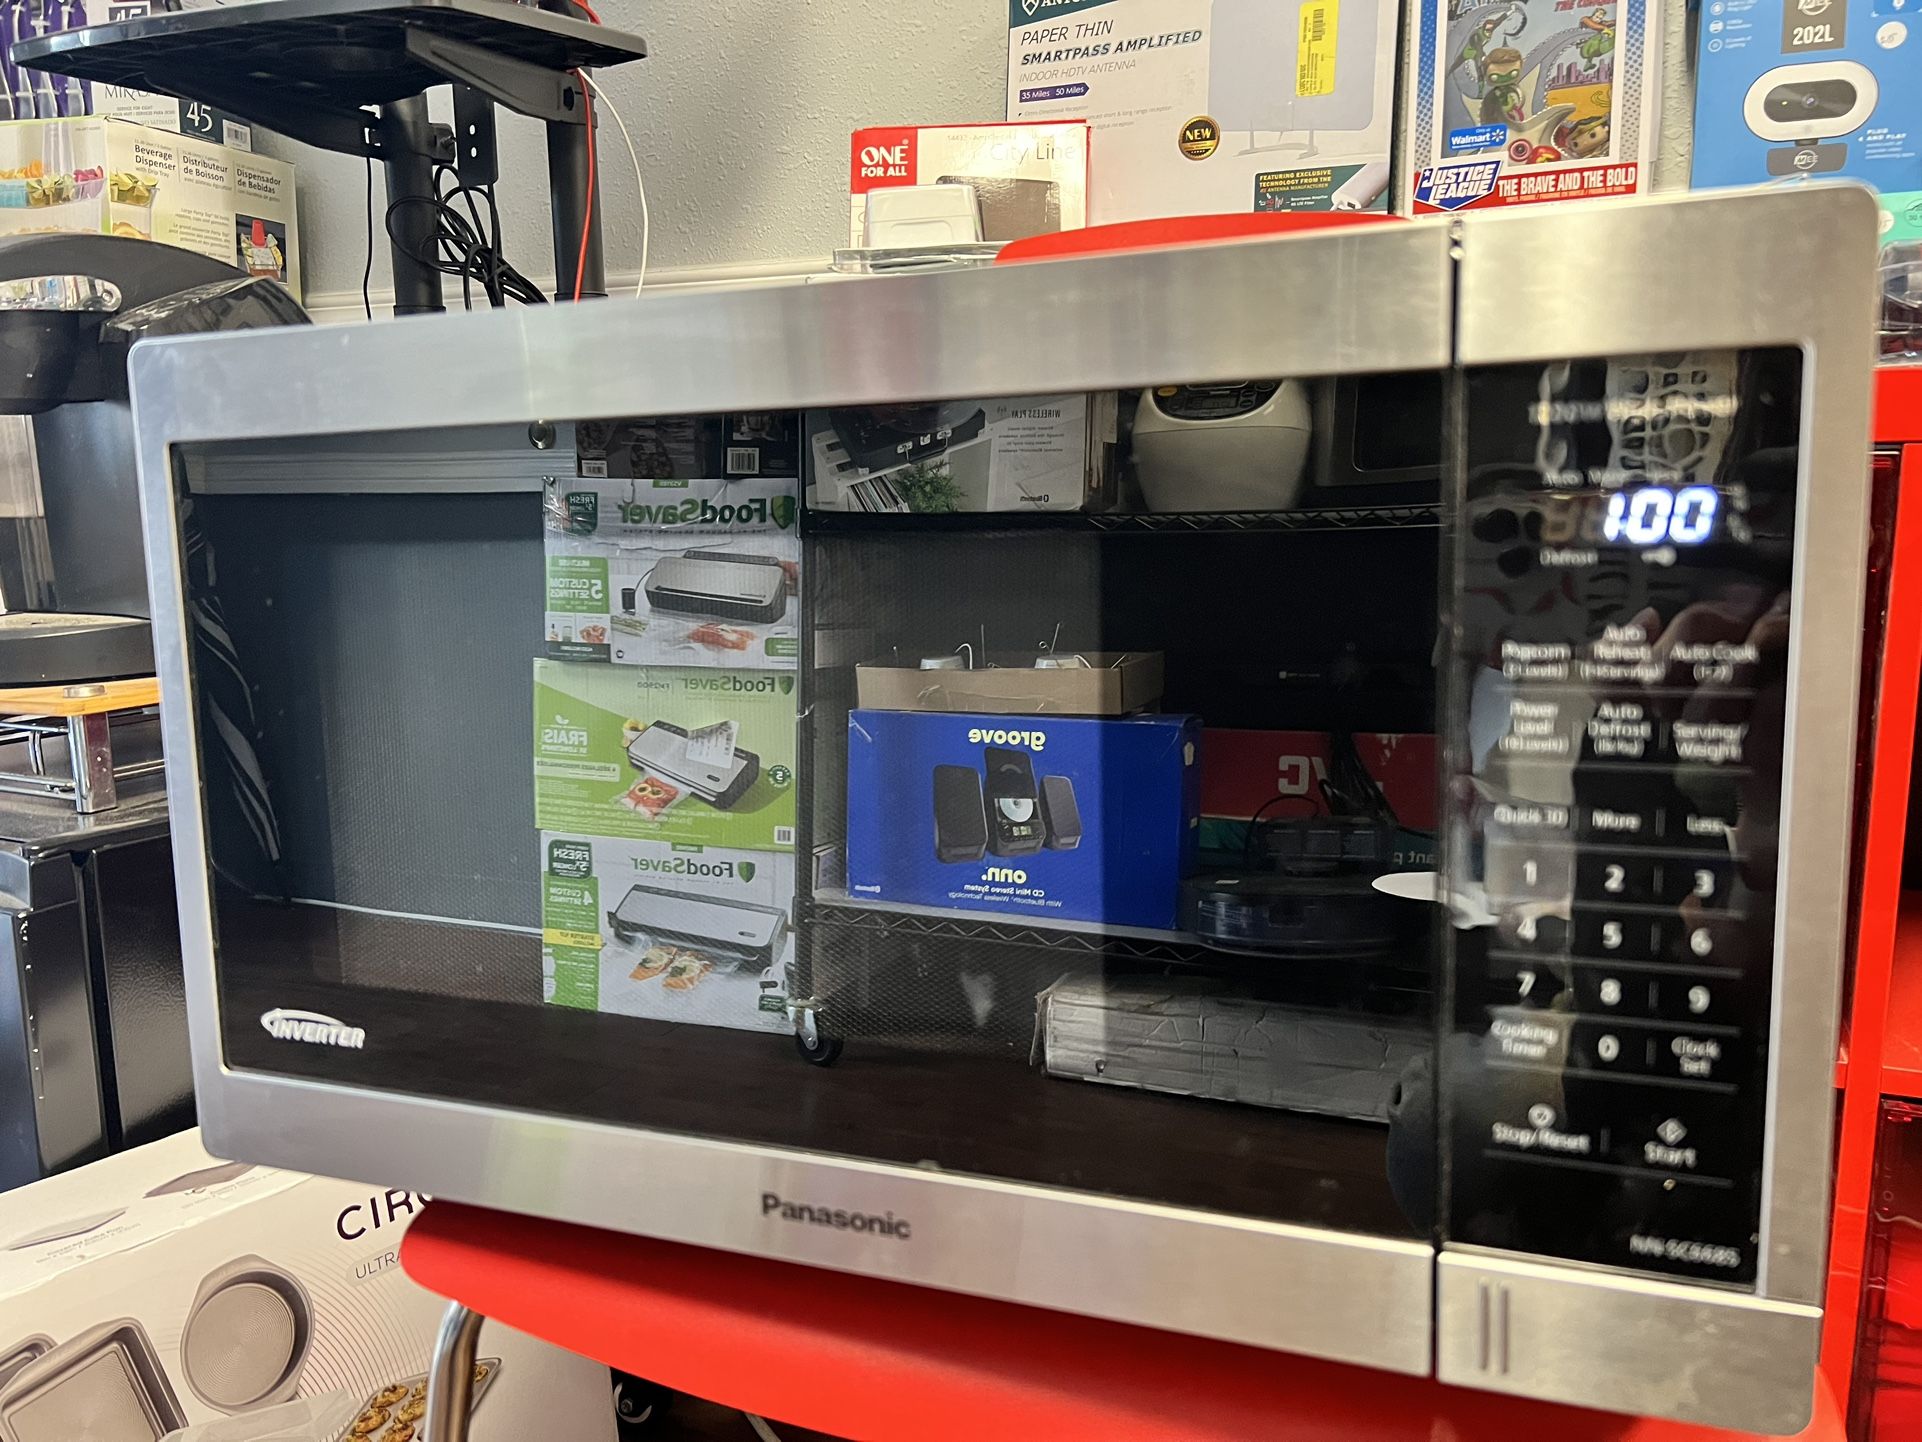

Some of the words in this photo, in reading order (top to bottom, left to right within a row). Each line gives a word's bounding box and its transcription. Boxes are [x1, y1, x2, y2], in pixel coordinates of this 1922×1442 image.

[1020, 26, 1069, 46] PAPER
[1075, 19, 1114, 39] THIN
[1792, 24, 1835, 46] 202L
[1021, 43, 1111, 65] SMARTPASS
[1114, 30, 1202, 53] AMPLIFIED
[1019, 69, 1058, 83] INDOOR
[1061, 66, 1086, 78] HDTV
[1088, 59, 1136, 74] ANTENNA
[1021, 91, 1031, 99] 35
[1032, 90, 1050, 98] Miles
[1055, 87, 1065, 96] 50
[1066, 86, 1084, 94] Miles
[187, 102, 213, 132] 45
[1185, 128, 1212, 141] NEW
[1451, 133, 1491, 145] Walmart
[135, 144, 172, 161] Beverage
[136, 155, 176, 170] Dispenser
[183, 155, 228, 173] Distributeur
[861, 145, 908, 165] ONE
[184, 166, 193, 175] de
[195, 168, 224, 182] Boisson
[237, 168, 281, 186] Dispensador
[861, 167, 884, 178] FOR
[887, 166, 907, 177] ALL
[1259, 173, 1295, 181] FEATURING
[1296, 169, 1331, 179] EXCLUSIVE
[1259, 180, 1299, 188] TECHNOLOGY
[1422, 163, 1494, 187] JUSTICE
[1498, 179, 1519, 197] THE
[1520, 174, 1556, 195] BRAVE
[1557, 172, 1580, 191] AND
[1582, 170, 1606, 188] THE
[1606, 167, 1636, 186] BOLD
[237, 179, 247, 187] de
[248, 181, 276, 194] Bebidas
[1430, 180, 1492, 204] LEAGUE
[1523, 860, 1538, 886] 1
[1604, 864, 1625, 892] 2
[1694, 869, 1715, 897] 3
[1516, 917, 1538, 943] 4
[1602, 921, 1623, 949] 5
[1690, 927, 1713, 956] 6
[1516, 970, 1537, 997] 7
[1600, 977, 1622, 1006] 8
[1688, 985, 1711, 1014] 9
[271, 1017, 365, 1049] INVERTER
[1598, 1034, 1620, 1062] 0
[761, 1192, 912, 1239] Panasonic
